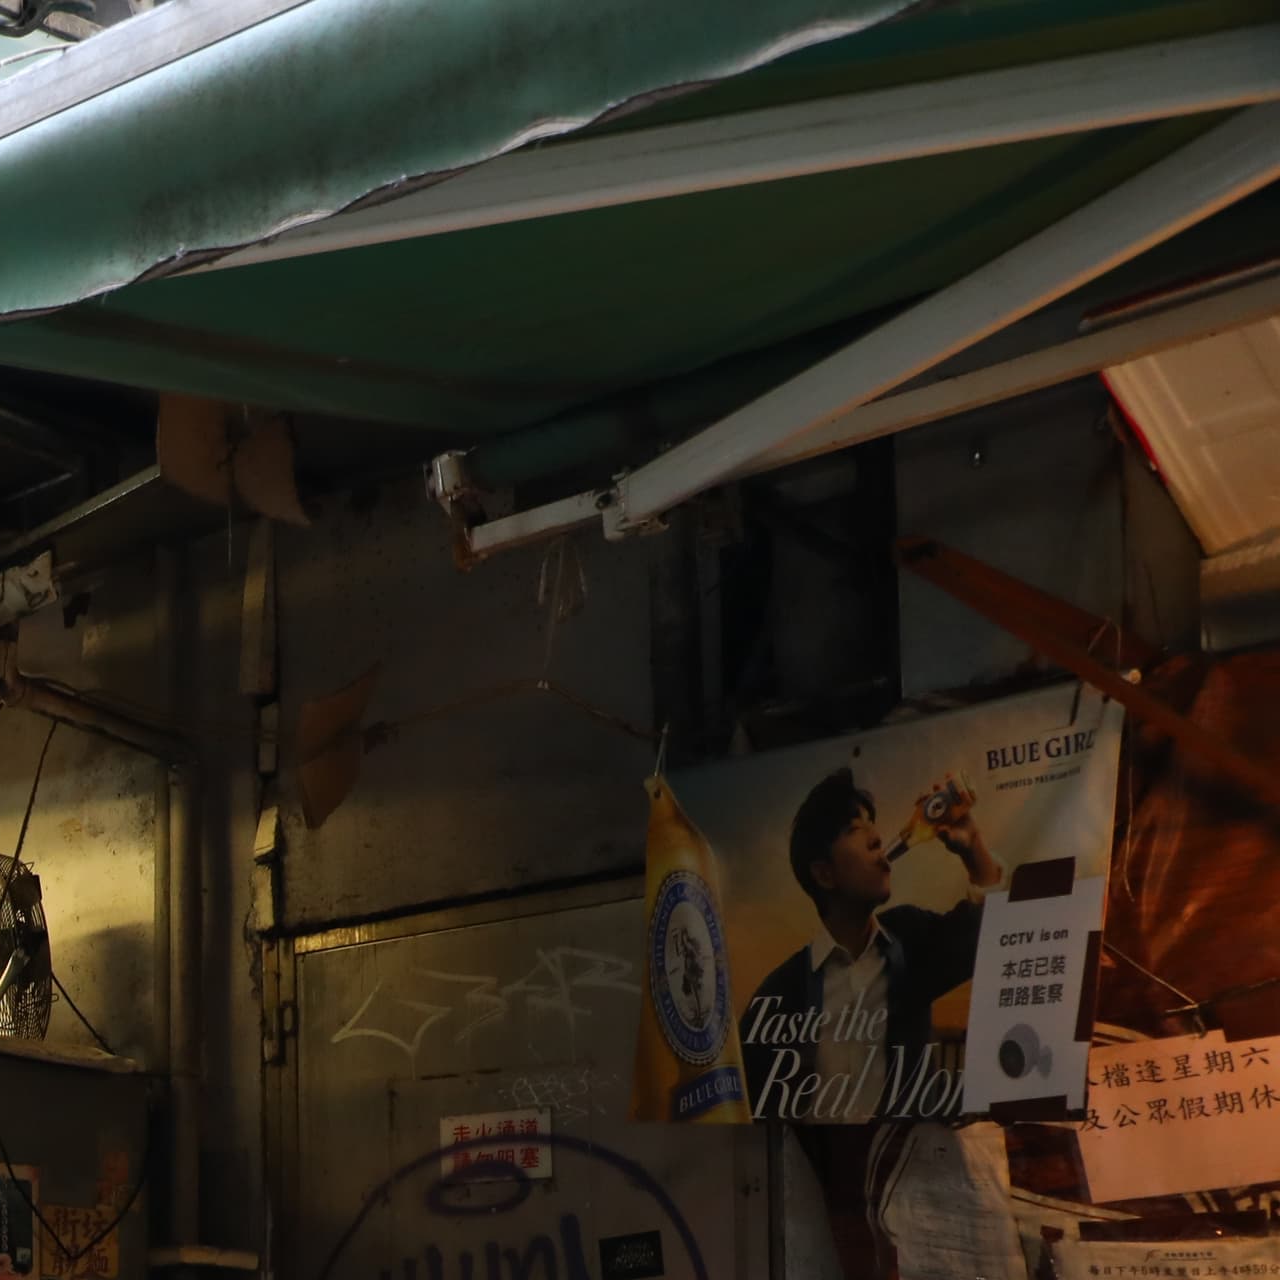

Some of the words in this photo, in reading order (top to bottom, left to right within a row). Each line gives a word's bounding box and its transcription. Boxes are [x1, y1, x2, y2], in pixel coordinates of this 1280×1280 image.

[987, 741, 1040, 770] BLUE
[1045, 728, 1098, 757] GIRL
[999, 931, 1034, 946] CCTV
[1040, 928, 1051, 941] is
[1053, 929, 1069, 939] on
[1001, 955, 1066, 980] 本店已裝
[998, 984, 1063, 1009] 閉路監察
[744, 995, 838, 1047] Taste
[834, 996, 889, 1043] the
[754, 1045, 876, 1121] Real
[1087, 1047, 1272, 1092] 檔逢星期六
[678, 1083, 713, 1114] BLUE
[453, 1118, 538, 1145] 走火通道
